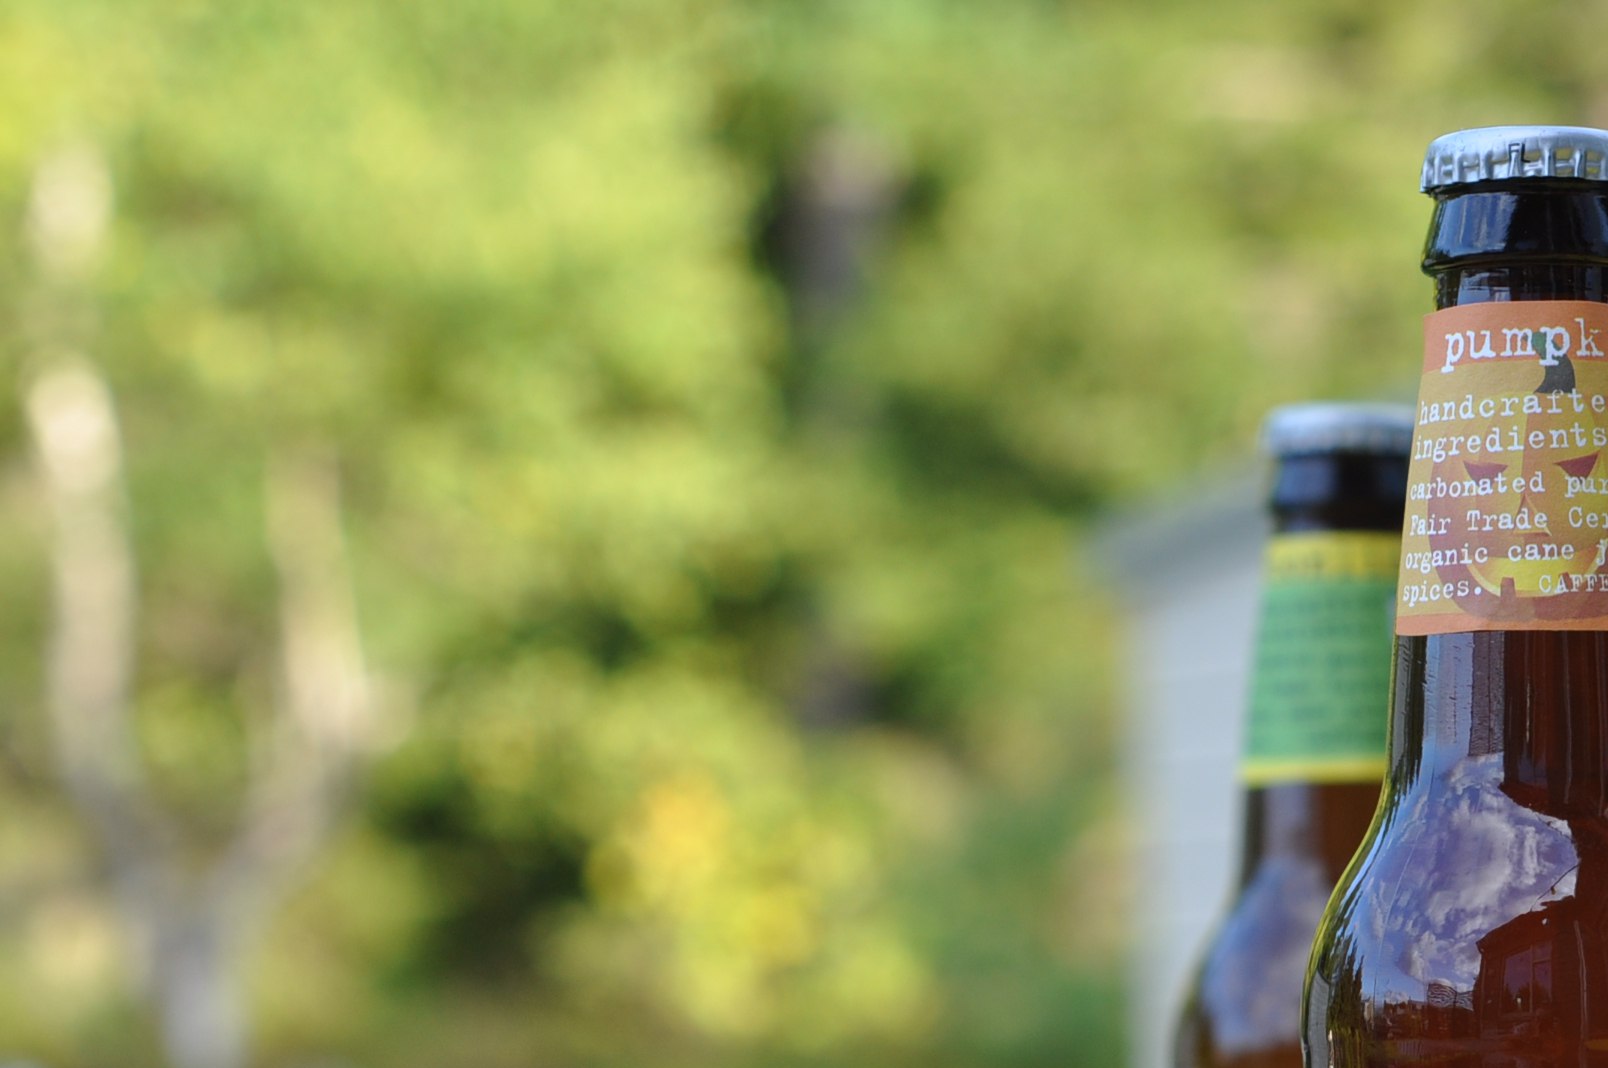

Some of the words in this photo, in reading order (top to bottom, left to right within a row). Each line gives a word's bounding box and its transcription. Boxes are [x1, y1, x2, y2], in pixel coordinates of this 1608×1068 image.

[1409, 470, 1546, 501] carbonated
[1409, 514, 1451, 536] Fair
[1466, 507, 1549, 532] Trade
[1404, 546, 1489, 574] organic
[1507, 542, 1575, 561] cane
[1402, 579, 1482, 607] spices.
